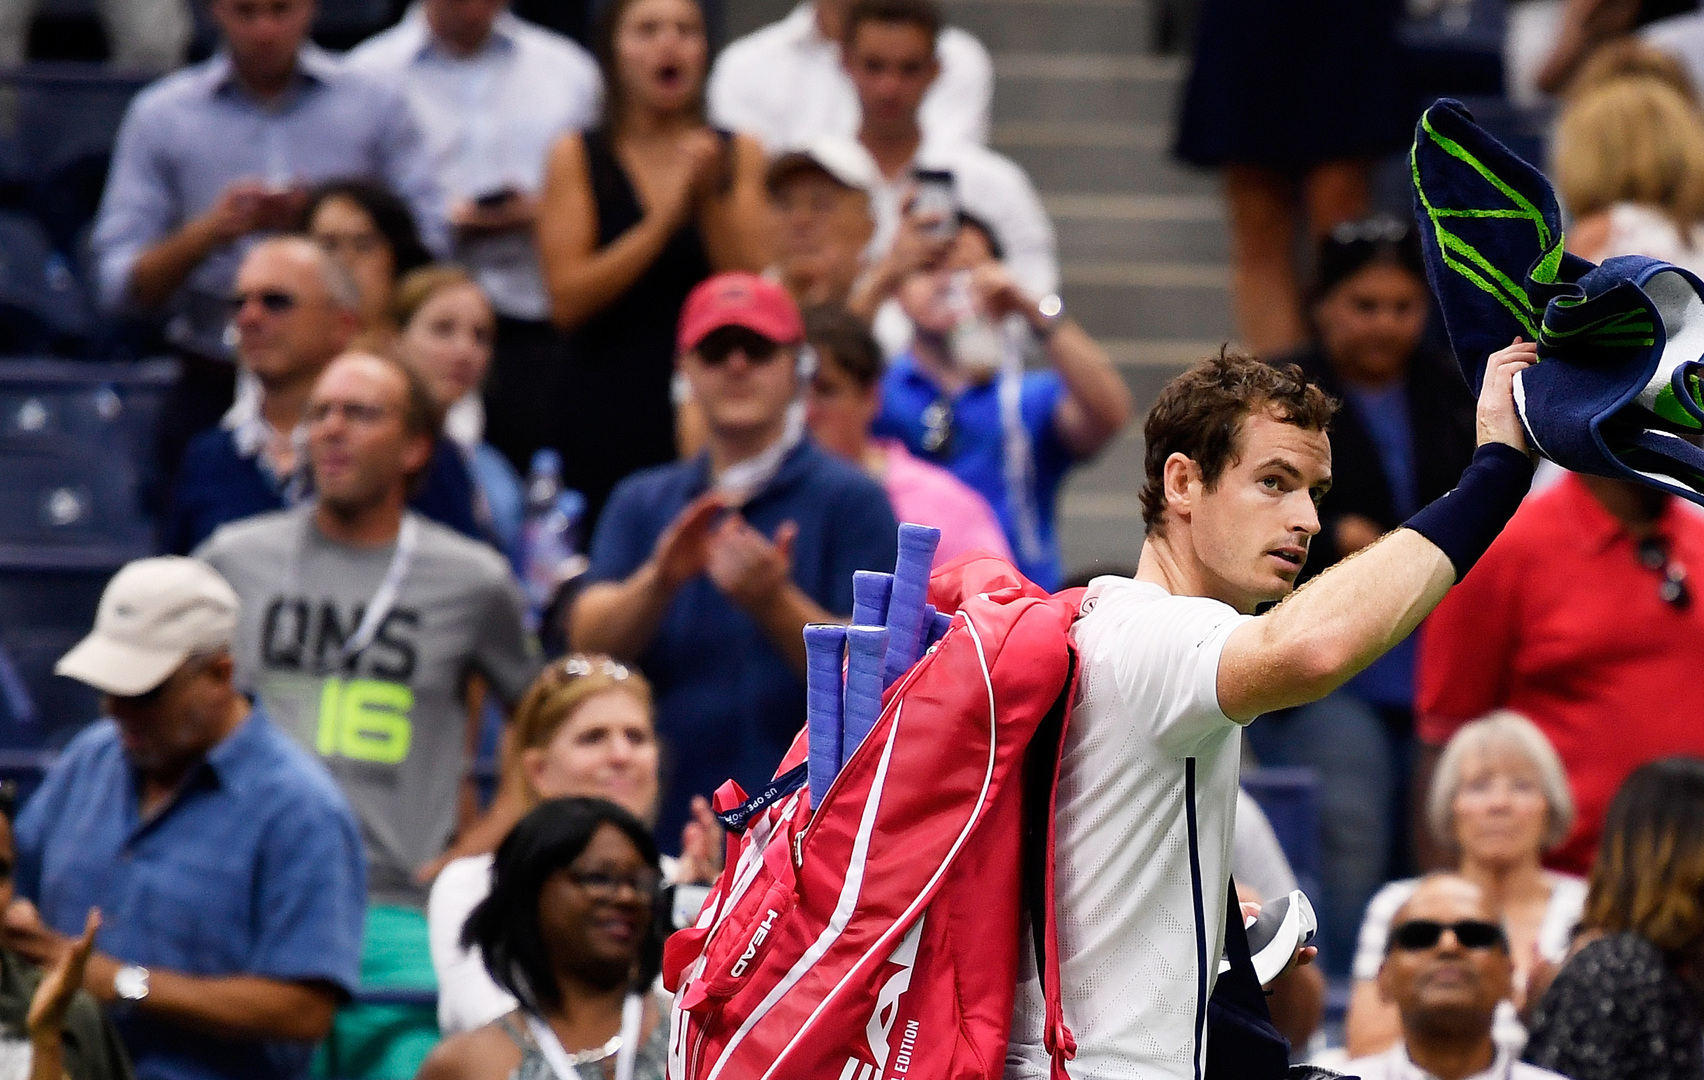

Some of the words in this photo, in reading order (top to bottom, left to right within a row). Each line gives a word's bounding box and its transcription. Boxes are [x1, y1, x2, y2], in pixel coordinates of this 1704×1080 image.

[262, 595, 419, 681] QNS
[316, 676, 415, 765] 16
[764, 786, 778, 800] US
[730, 908, 779, 978] HEAD
[894, 1019, 920, 1075] EDITION
